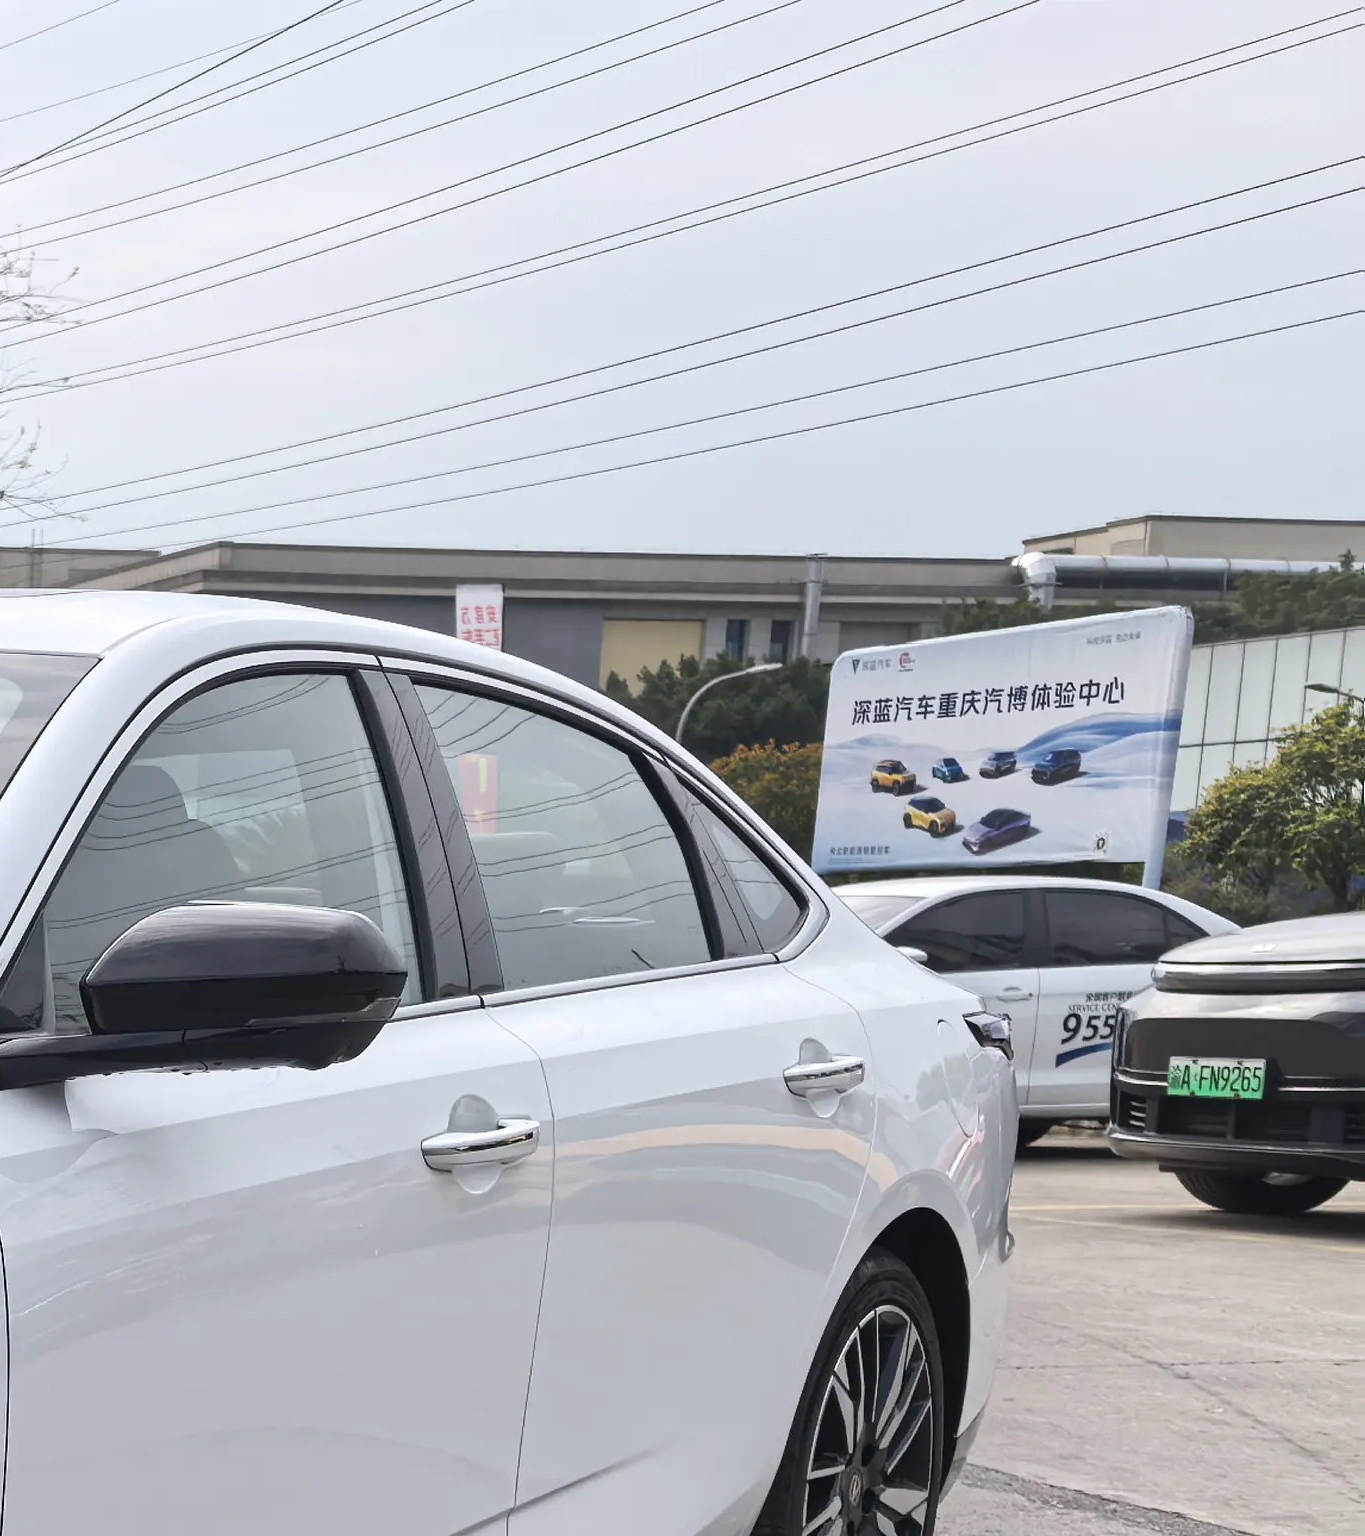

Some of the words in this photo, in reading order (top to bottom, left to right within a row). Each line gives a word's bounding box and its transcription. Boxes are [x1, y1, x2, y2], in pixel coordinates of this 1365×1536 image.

[851, 676, 1125, 726] 深蓝汽车重庆汽博体验中心
